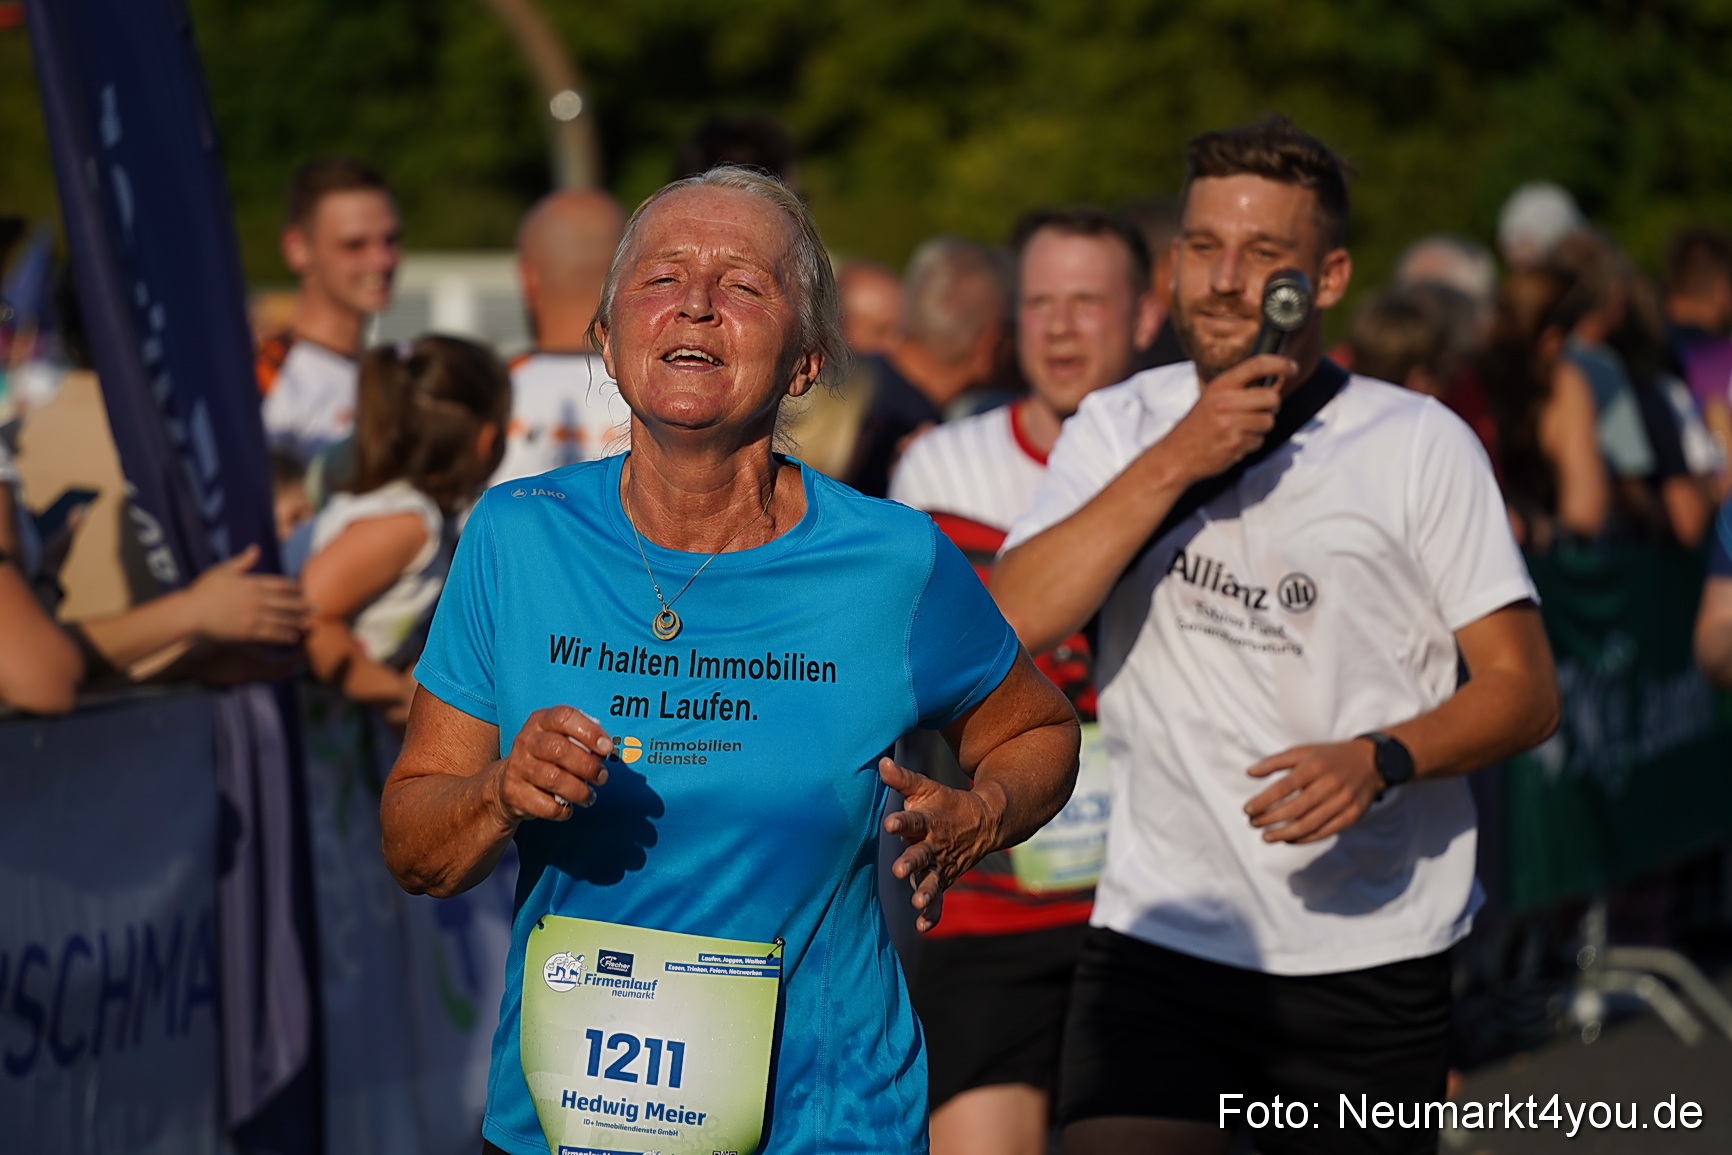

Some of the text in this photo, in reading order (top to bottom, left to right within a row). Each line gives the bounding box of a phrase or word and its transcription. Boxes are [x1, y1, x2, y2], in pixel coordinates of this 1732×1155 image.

[531, 488, 566, 500] JAKO
[1167, 550, 1269, 610] Allianz
[549, 634, 836, 683] Wir halten Immobilien
[609, 691, 758, 721] am Laufen.
[649, 738, 742, 752] immobilien
[647, 752, 708, 765] dienste
[722, 956, 744, 964] Joggen,
[744, 957, 767, 965] Walken
[686, 965, 708, 973] Trinken,
[709, 967, 728, 975] Feiern,
[728, 968, 763, 976] Netzwerken
[584, 973, 659, 991] Firmenlauf
[0, 907, 217, 1079] SCHMA
[611, 989, 655, 1000] neumarkt
[585, 1028, 686, 1089] 1211
[561, 1089, 707, 1126] Hedwig Meier
[595, 1120, 657, 1135] Immobiliendienste
[657, 1128, 679, 1137] GmbH
